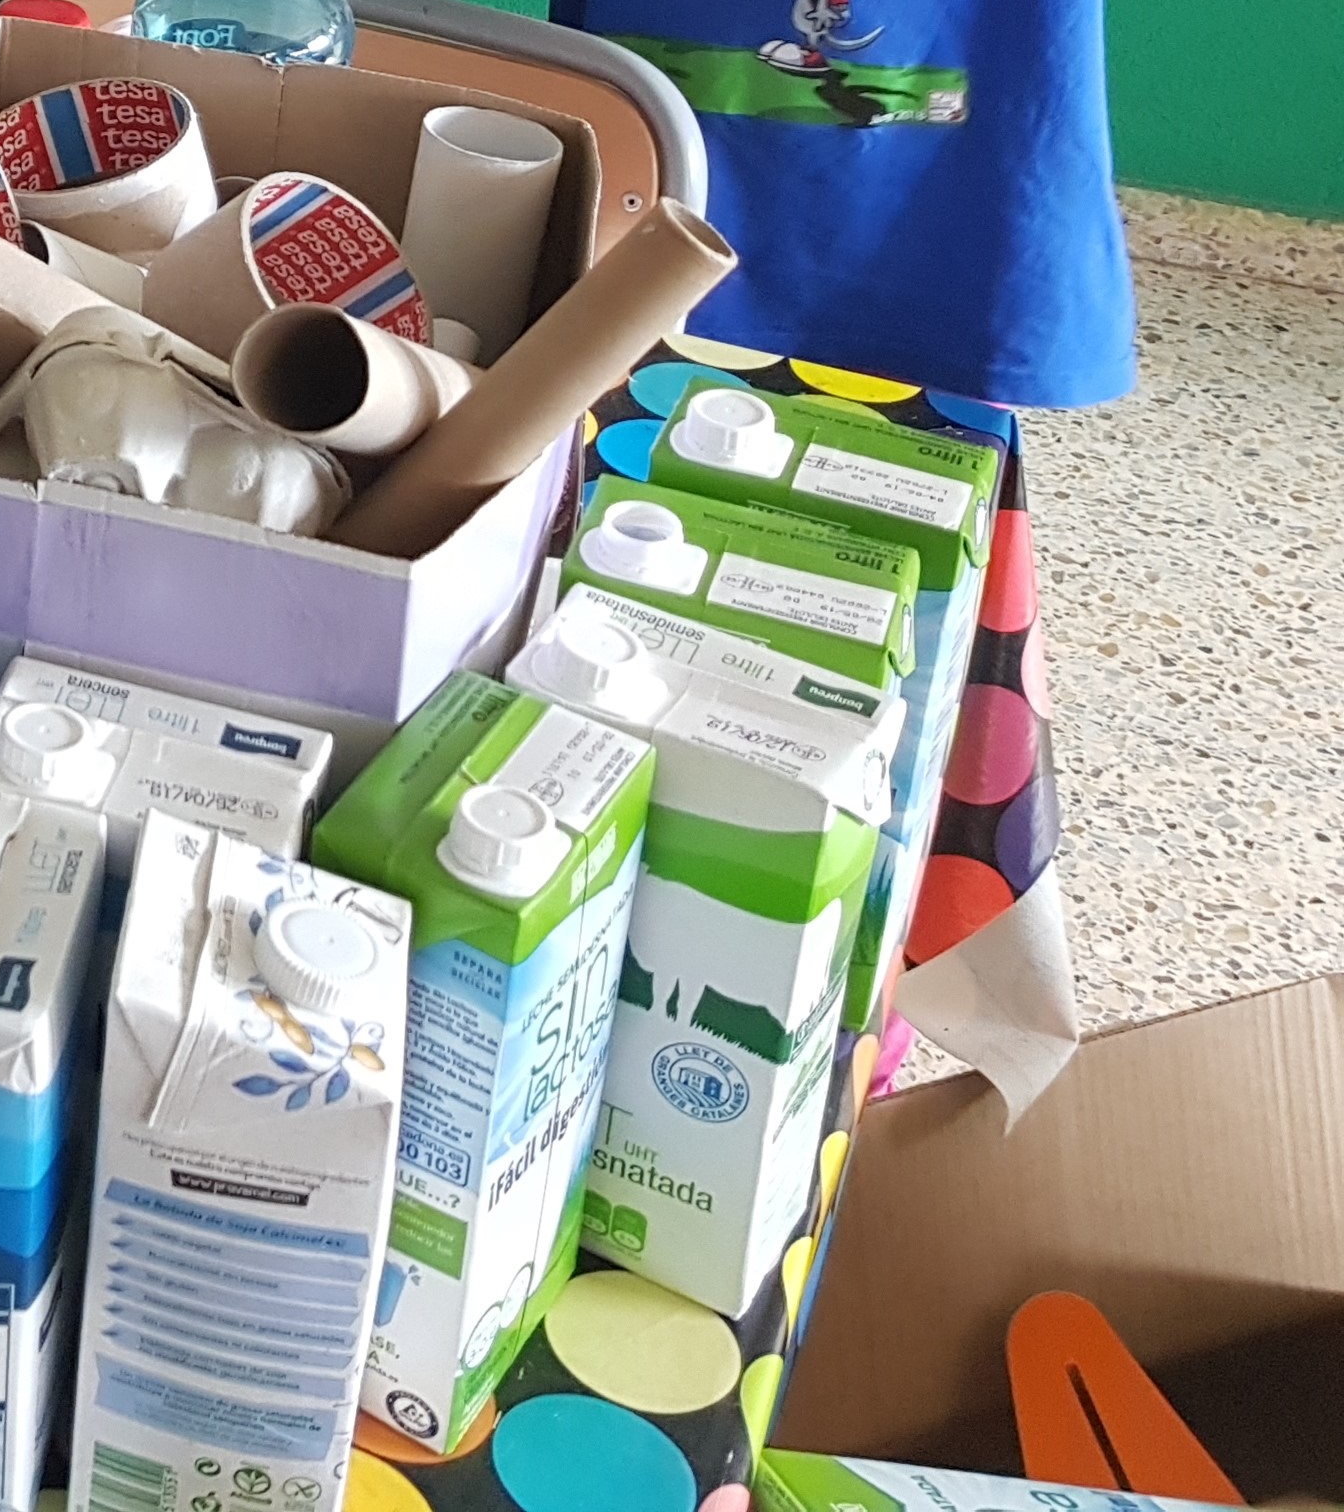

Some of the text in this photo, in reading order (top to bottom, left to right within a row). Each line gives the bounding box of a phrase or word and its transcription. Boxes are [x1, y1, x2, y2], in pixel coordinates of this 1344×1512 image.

[87, 81, 159, 101] tesa
[96, 102, 167, 126] tesa
[101, 126, 174, 150] tesa
[314, 217, 368, 271] tesa
[332, 205, 387, 259] tesa
[279, 241, 332, 295] tesa
[297, 229, 351, 283] tesa
[263, 254, 315, 303] tesa
[918, 444, 966, 468] litro
[835, 549, 886, 572] litro
[584, 590, 707, 643] semidesnatada
[721, 652, 763, 682] litre
[66, 673, 131, 701] sencera
[807, 684, 865, 713] bonpreu
[147, 705, 190, 733] litre
[520, 991, 554, 1034] LECHE
[531, 941, 610, 1076] sin
[522, 978, 618, 1124] lactosa
[674, 1047, 734, 1074] LLET DE
[422, 1149, 463, 1181] 103
[622, 1140, 660, 1164] UHT
[396, 1169, 462, 1210] UE...?
[591, 1144, 714, 1214] snatada
